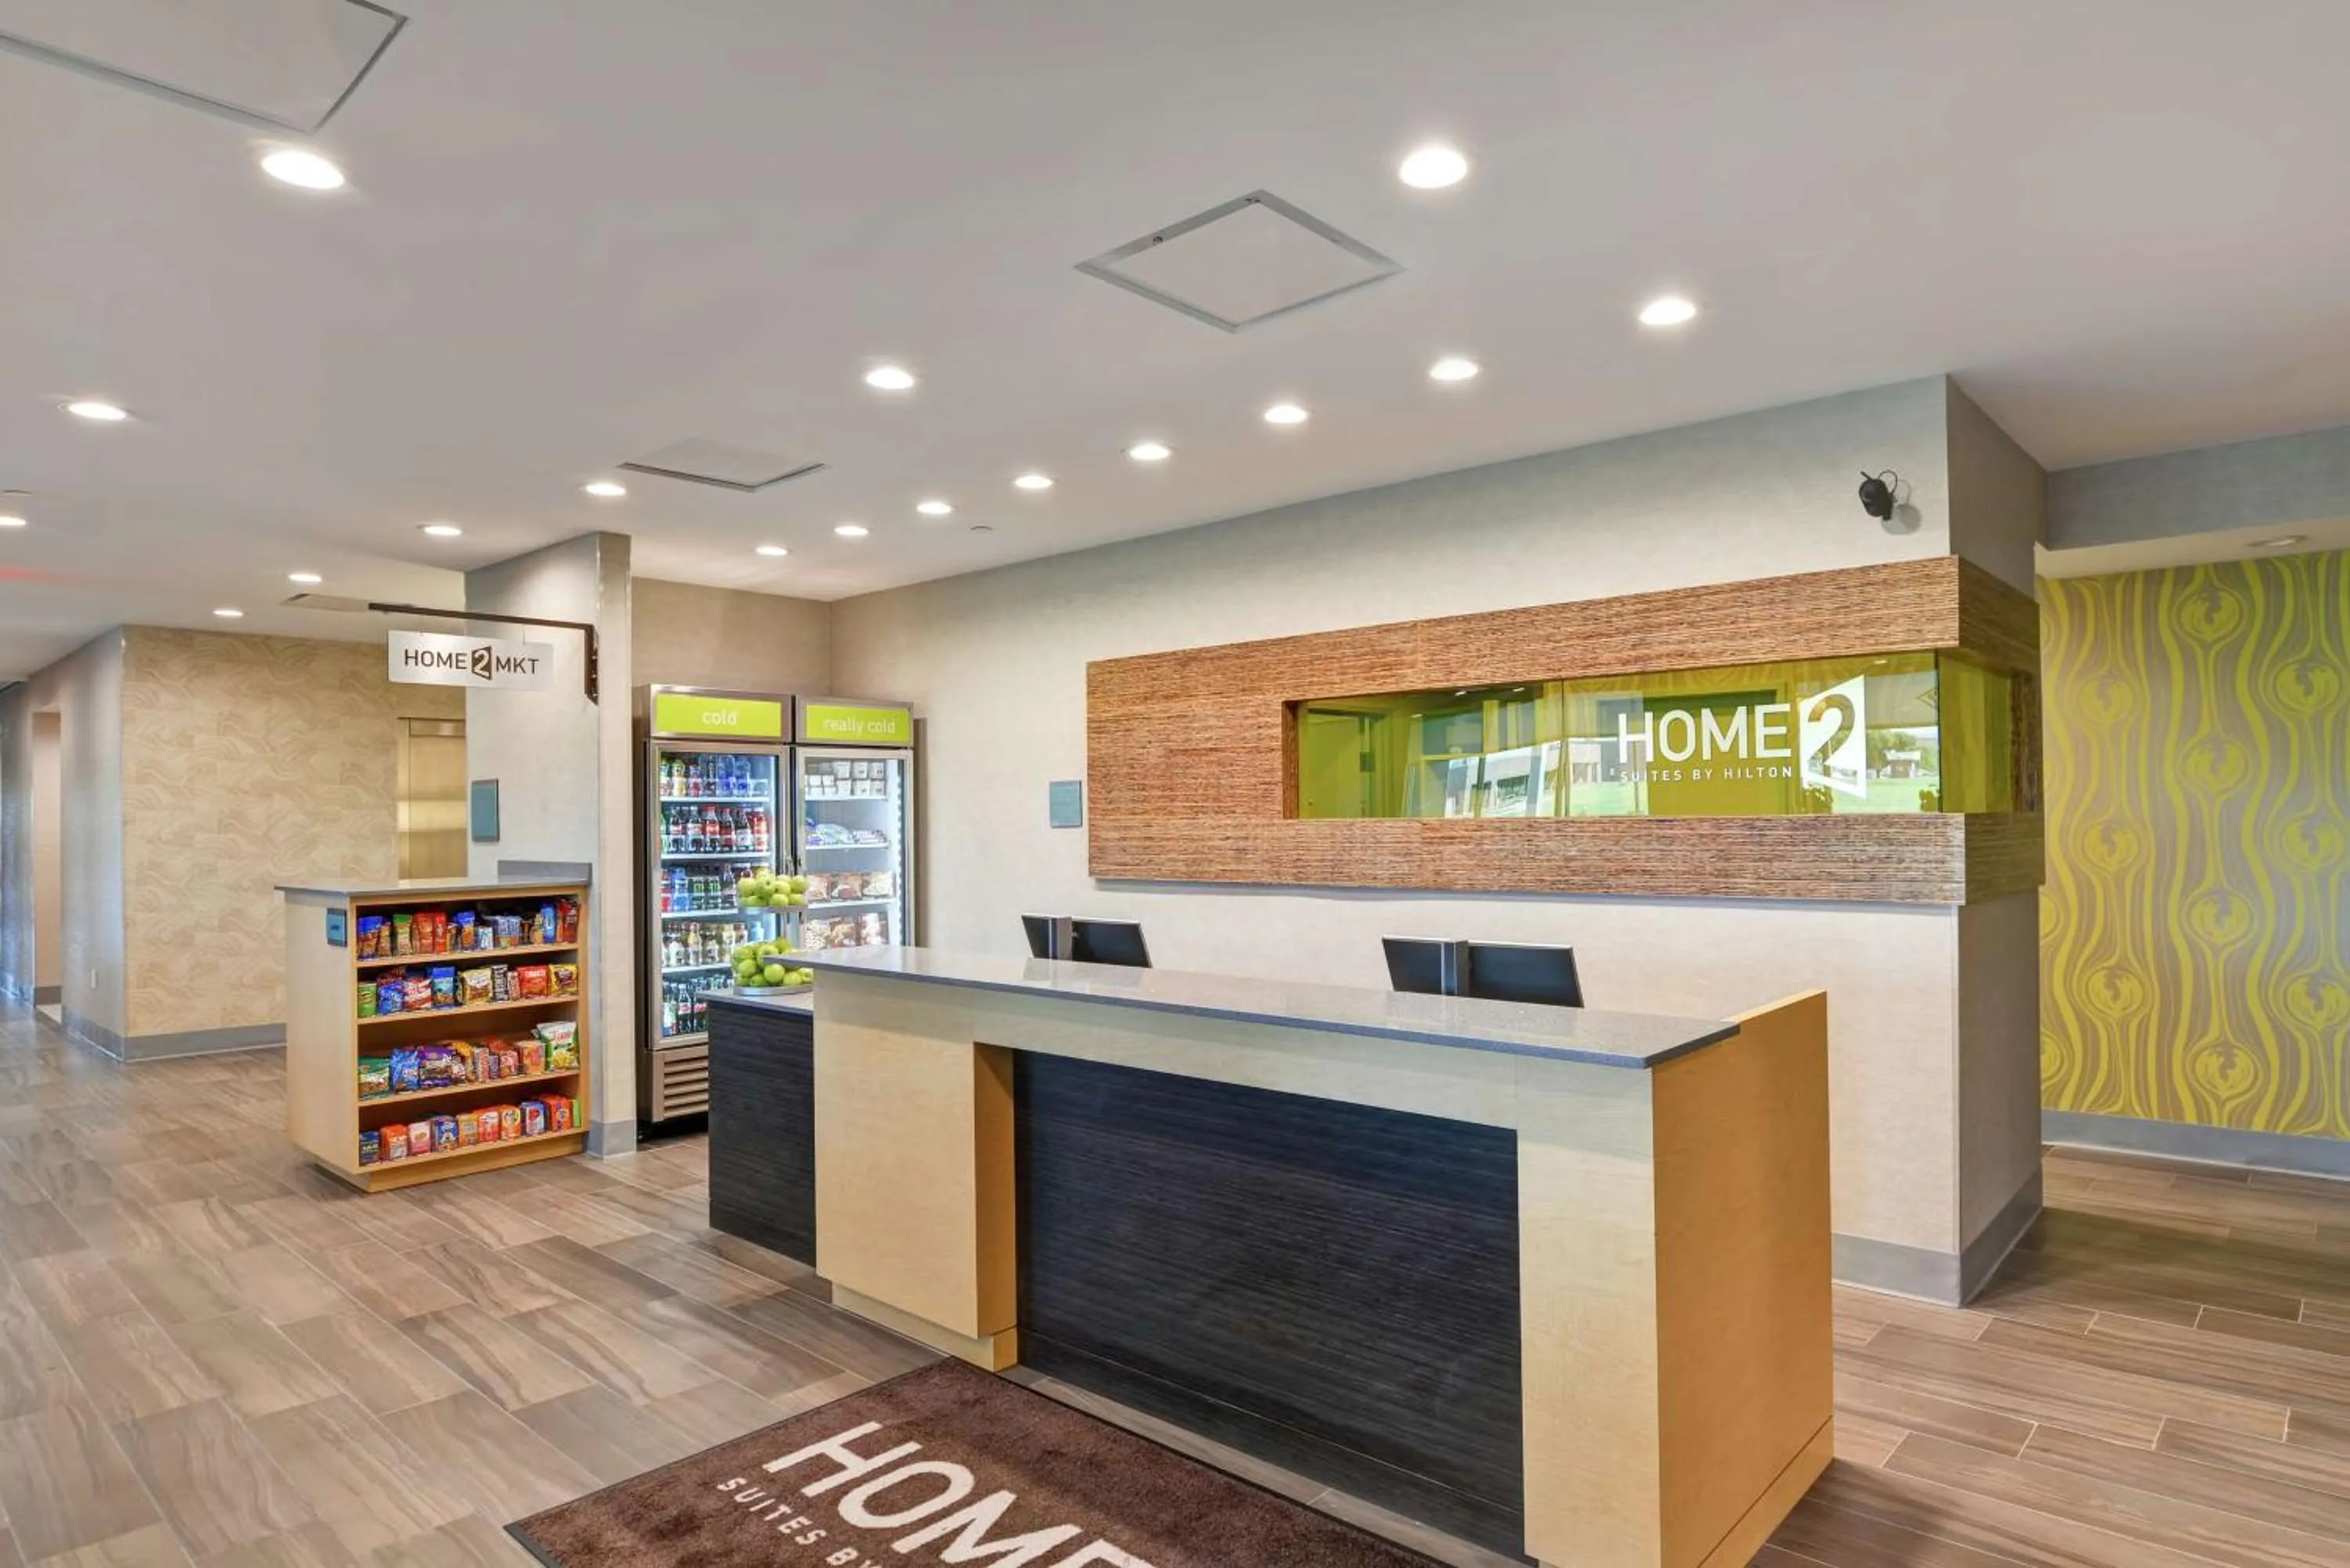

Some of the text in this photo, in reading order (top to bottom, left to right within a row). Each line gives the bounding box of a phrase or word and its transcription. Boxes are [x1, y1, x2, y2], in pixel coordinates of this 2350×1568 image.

[404, 647, 540, 679] HOME 2 MKT
[702, 709, 738, 726] cold
[823, 717, 895, 734] really cold
[1618, 687, 1861, 790] HOME 2
[1620, 765, 1792, 783] SUITES BY HILTON
[717, 1477, 827, 1546] SUITES
